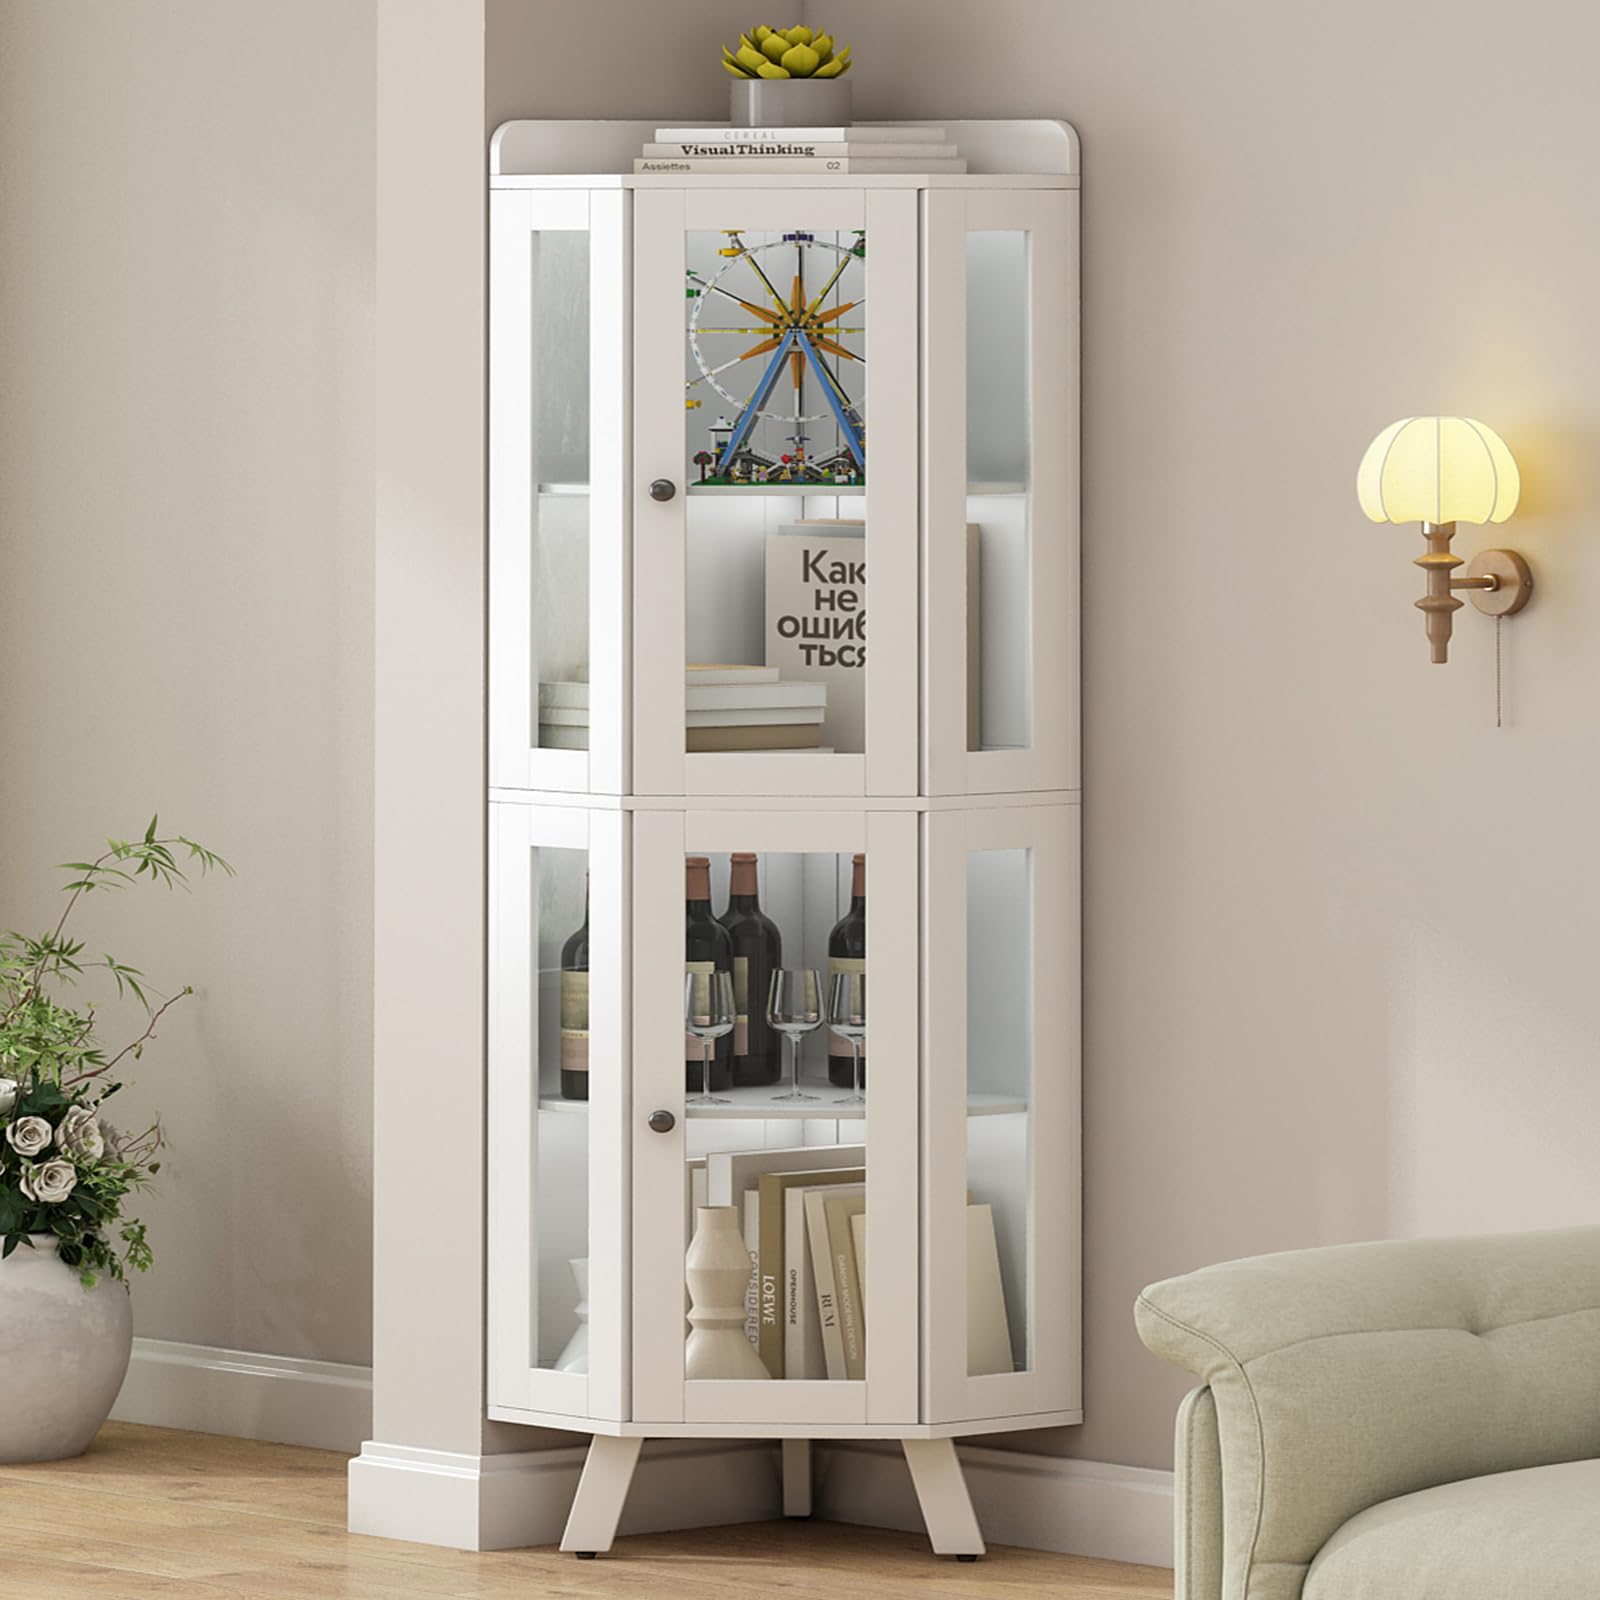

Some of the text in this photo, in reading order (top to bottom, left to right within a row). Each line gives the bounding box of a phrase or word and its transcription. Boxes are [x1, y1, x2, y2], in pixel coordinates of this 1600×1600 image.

[724, 131, 776, 140] CEREAL
[642, 161, 841, 171] Assiettes 02
[802, 549, 866, 584] Как
[814, 589, 859, 612] не
[762, 1275, 776, 1325] LOEWE
[789, 1269, 797, 1325] OPENHOUSE
